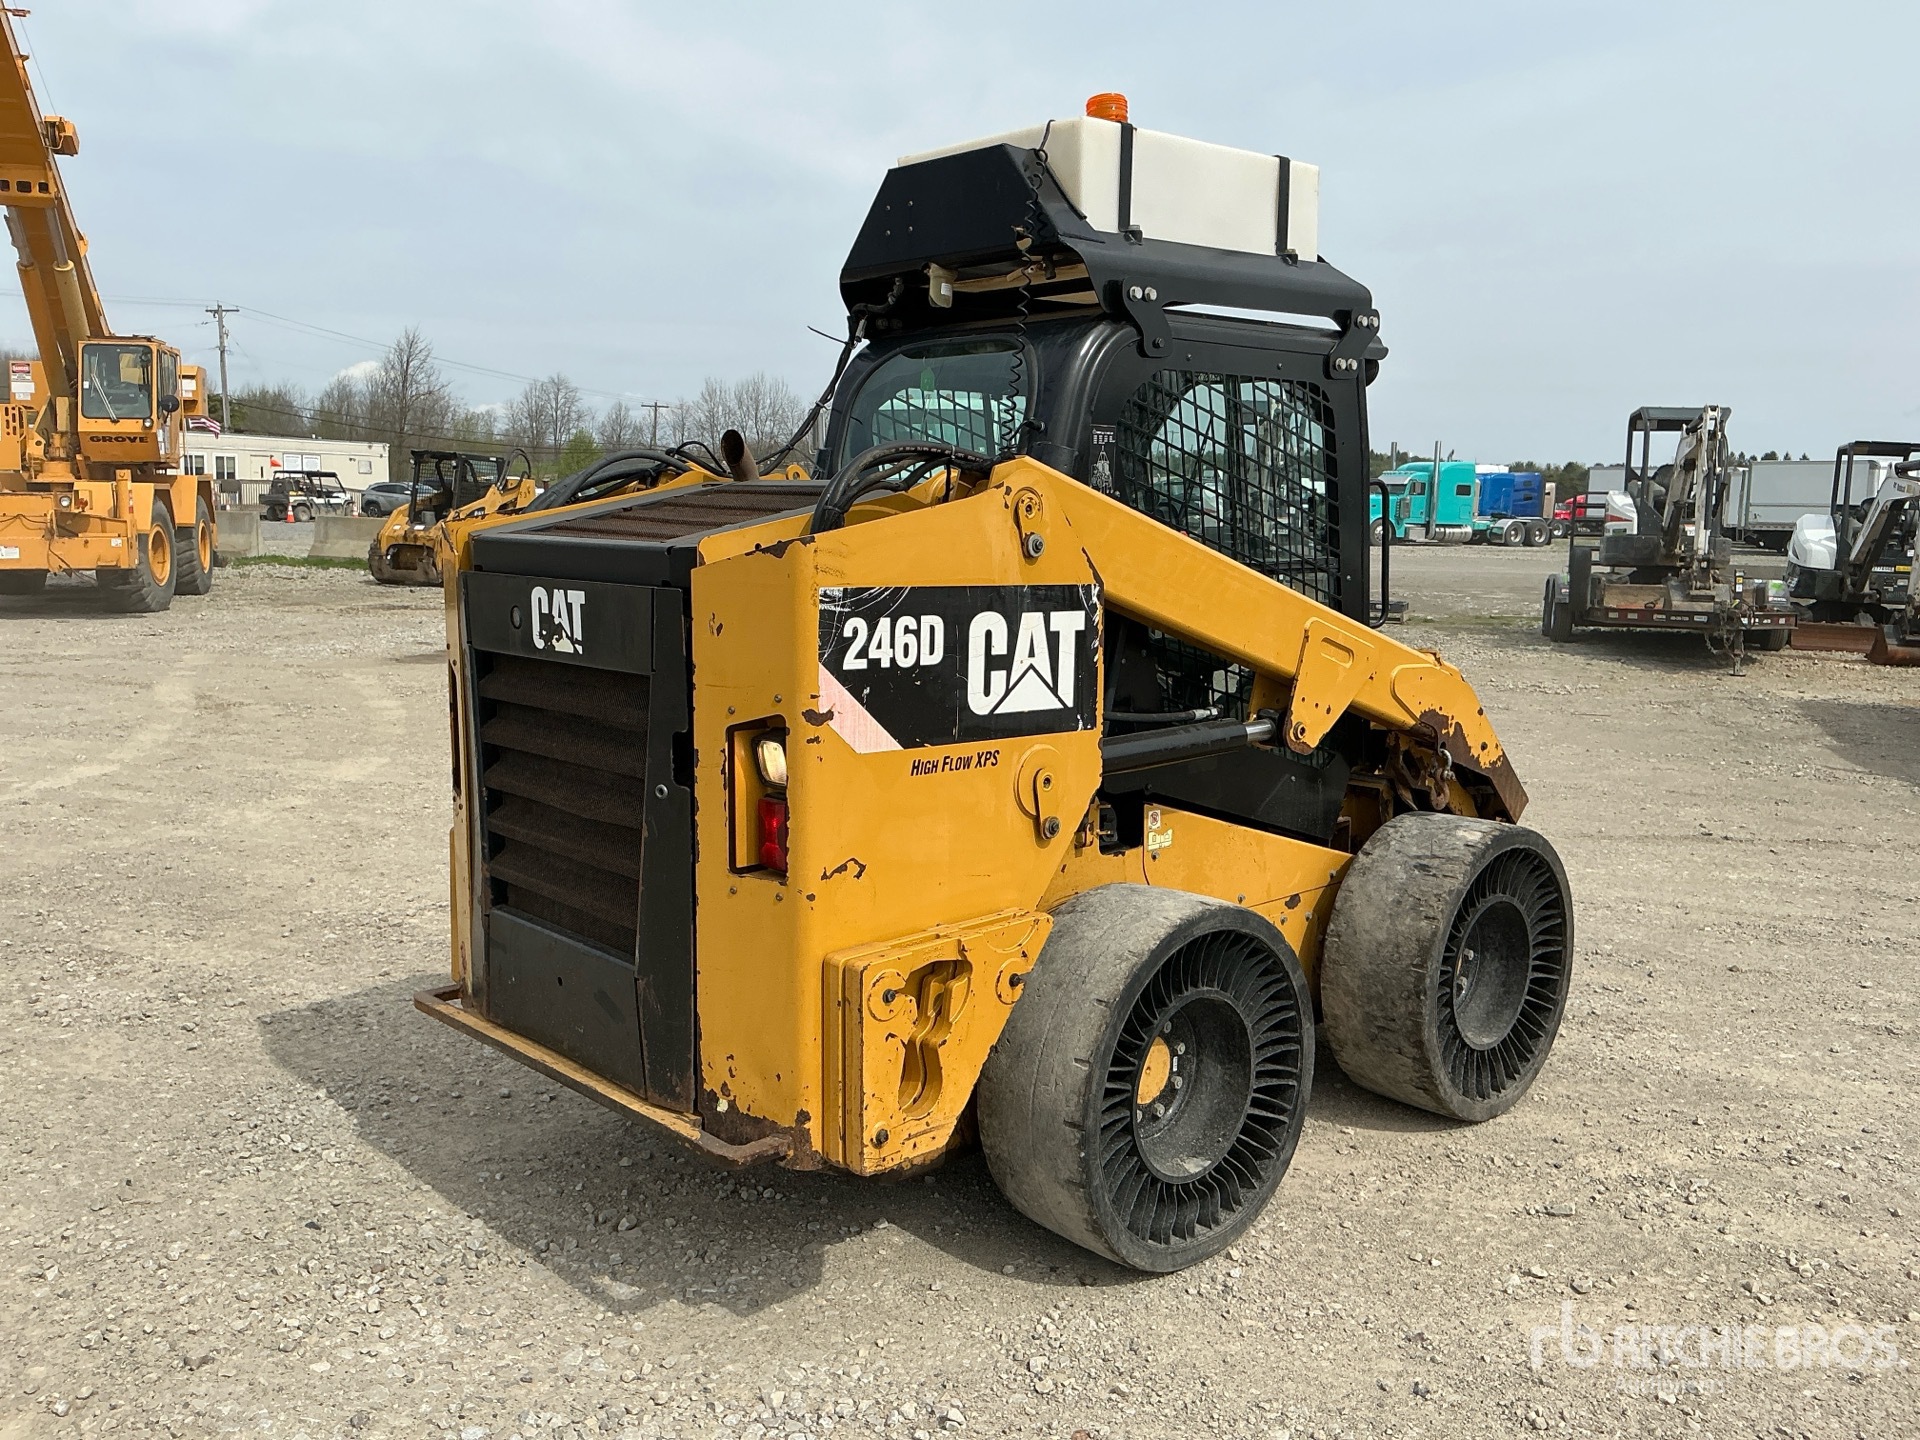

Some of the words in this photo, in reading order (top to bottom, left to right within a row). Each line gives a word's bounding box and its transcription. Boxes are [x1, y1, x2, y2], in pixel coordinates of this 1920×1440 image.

[89, 435, 149, 444] GROVE
[531, 586, 586, 654] CAT
[842, 614, 945, 671] 246D
[967, 610, 1086, 716] CAT
[974, 749, 1000, 769] XPS
